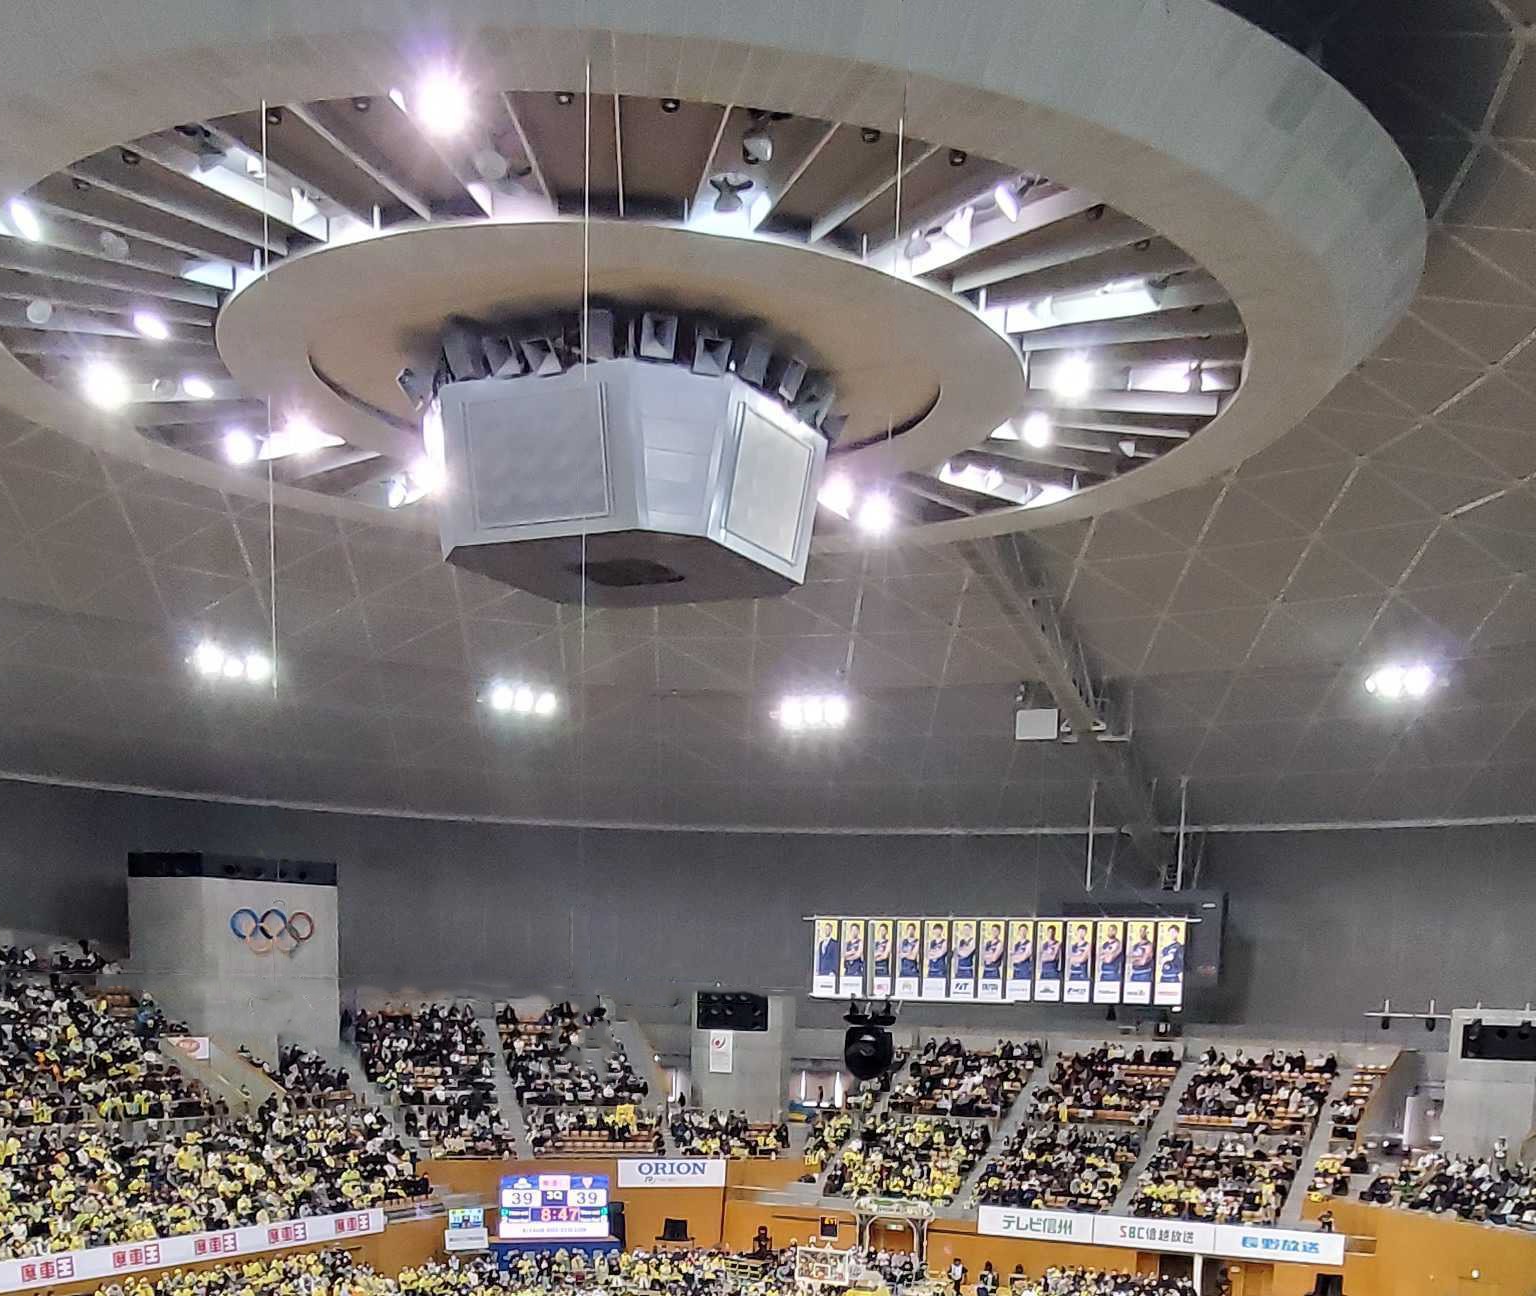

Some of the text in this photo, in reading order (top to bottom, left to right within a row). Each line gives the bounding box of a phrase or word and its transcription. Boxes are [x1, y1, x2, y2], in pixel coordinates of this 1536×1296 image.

[638, 1162, 707, 1175] ORION
[511, 1191, 533, 1205] 39
[576, 1191, 598, 1205] 39
[540, 1207, 579, 1222] 8:47
[1002, 1214, 1073, 1236] テレビ信州
[1119, 1225, 1194, 1245] SBC信越放送
